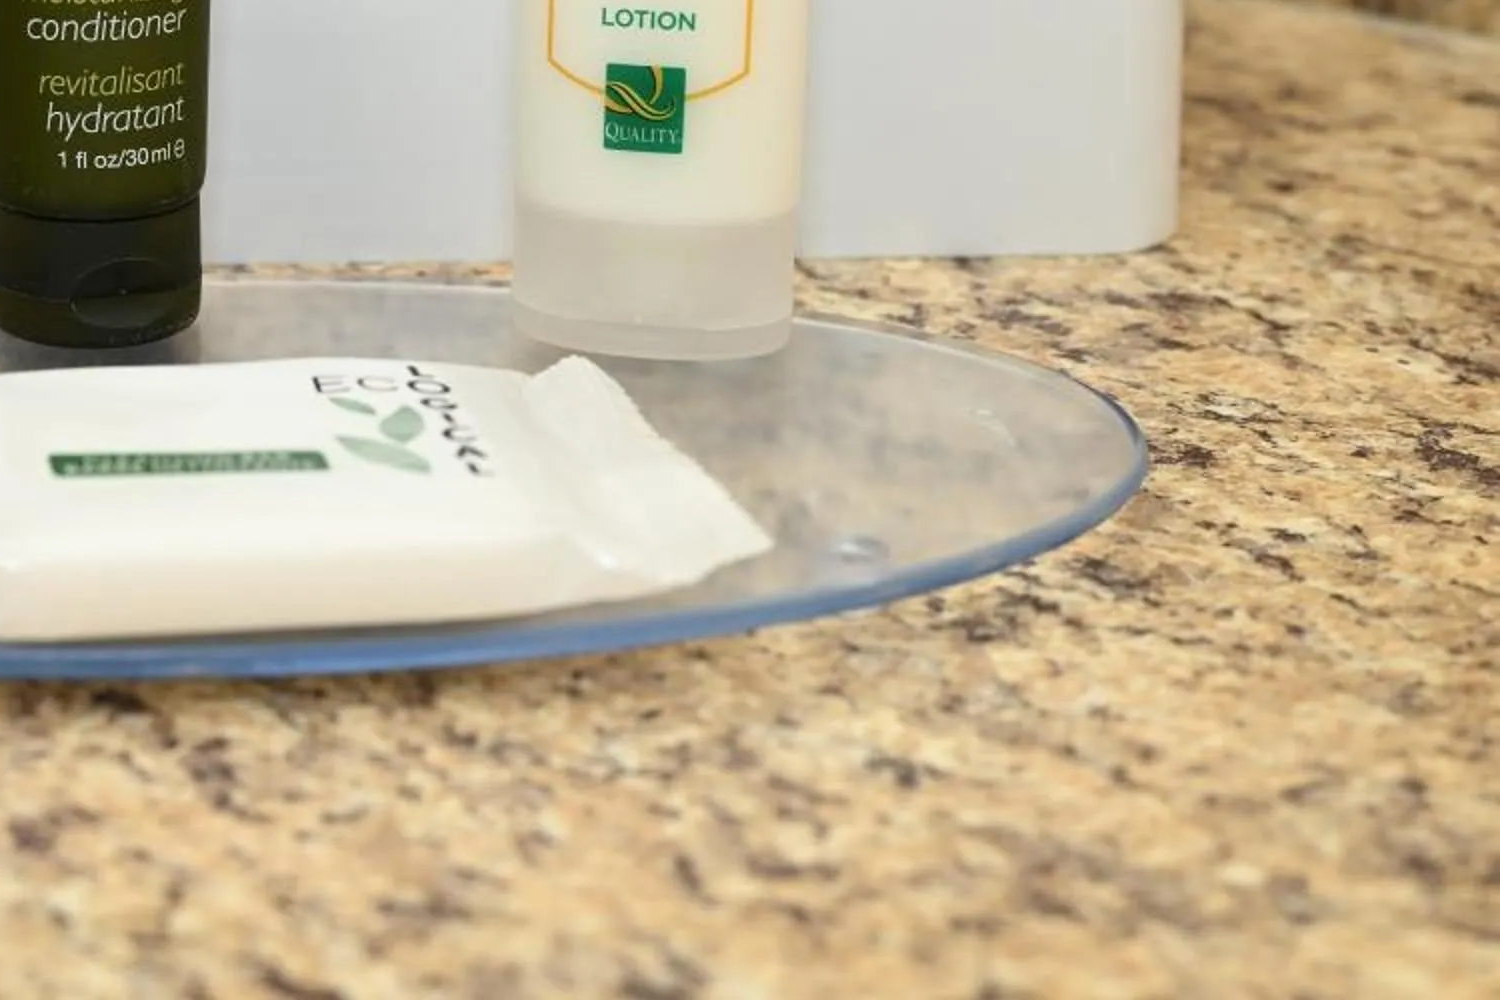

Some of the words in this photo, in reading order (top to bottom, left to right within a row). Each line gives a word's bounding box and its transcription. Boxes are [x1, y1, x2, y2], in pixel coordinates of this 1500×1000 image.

[27, 8, 188, 42] conditioner
[601, 7, 696, 32] LOTION
[39, 63, 184, 97] revitalisant
[46, 96, 185, 142] hydratant
[605, 121, 679, 144] QUALITY
[58, 151, 67, 169] 1
[75, 151, 87, 169] fl
